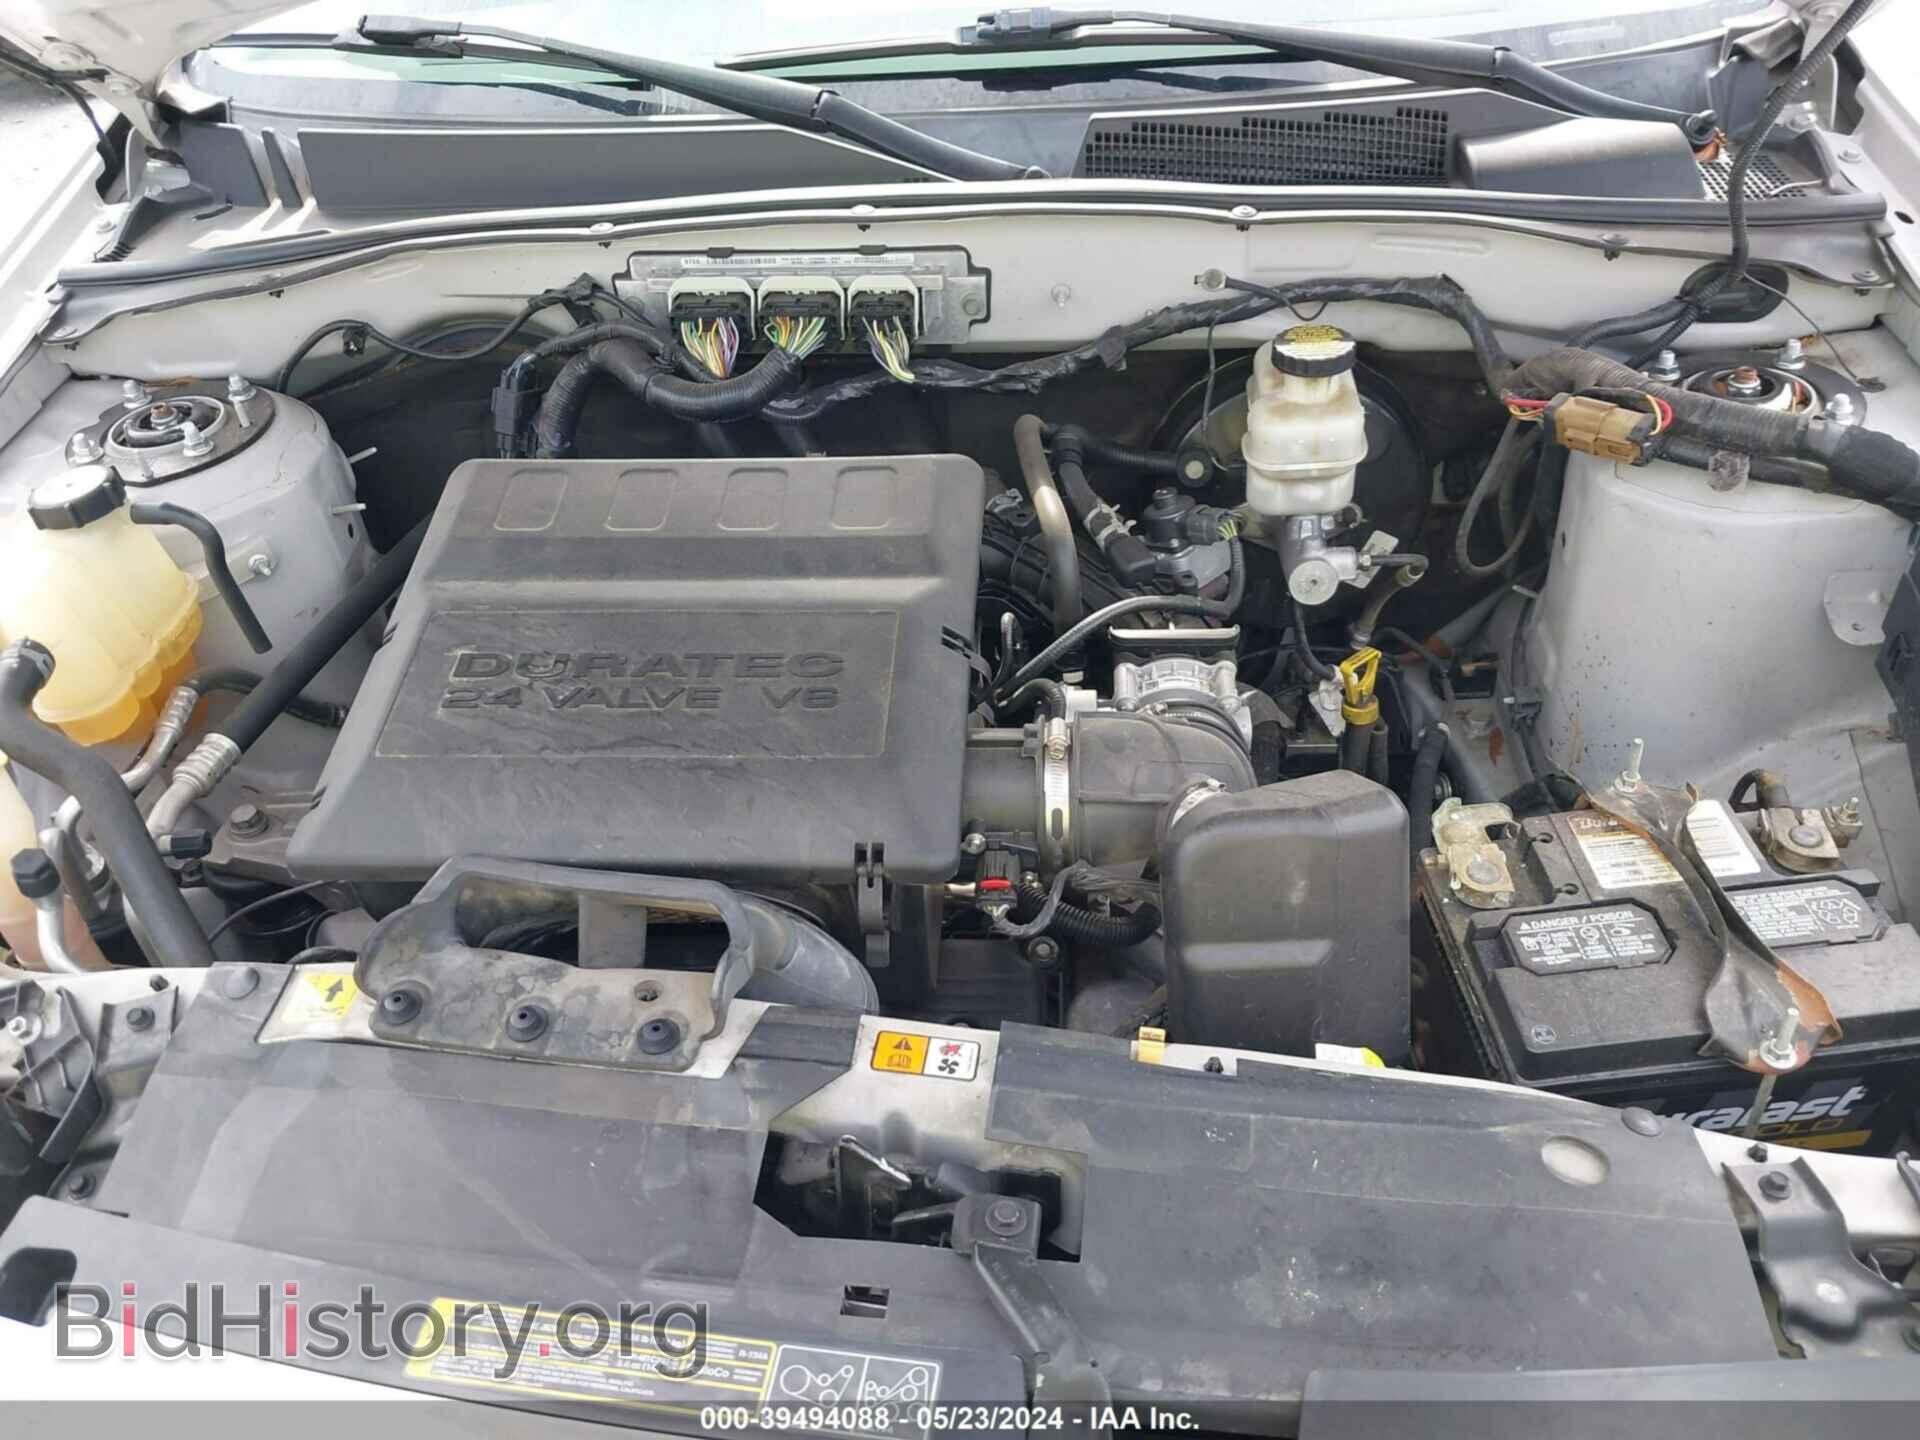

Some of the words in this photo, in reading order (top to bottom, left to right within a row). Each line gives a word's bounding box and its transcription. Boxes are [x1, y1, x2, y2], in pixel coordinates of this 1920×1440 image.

[451, 650, 845, 681] DURATEC
[441, 685, 523, 710] 24
[545, 685, 723, 710] VALVE
[1530, 915, 1579, 930] DANGER
[1589, 910, 1634, 923] POISON
